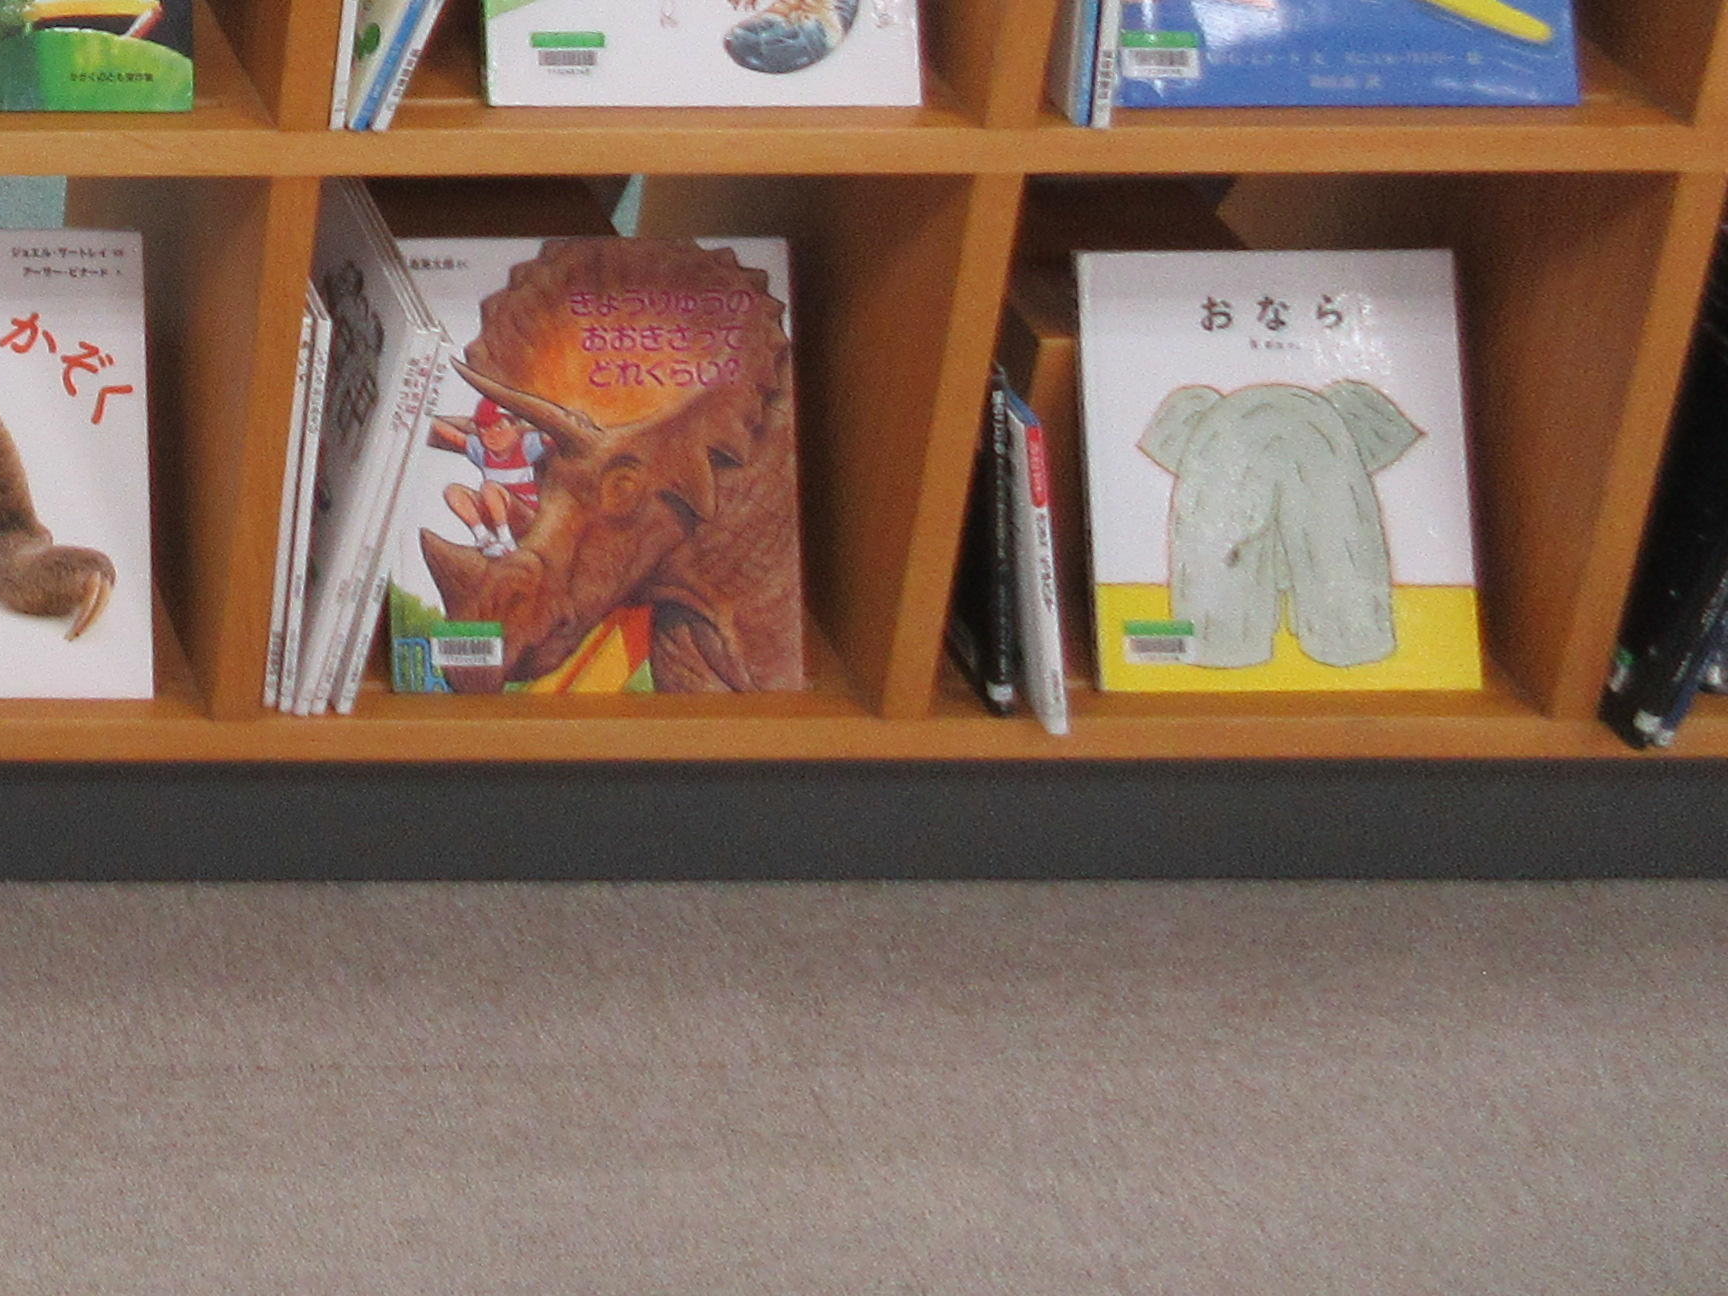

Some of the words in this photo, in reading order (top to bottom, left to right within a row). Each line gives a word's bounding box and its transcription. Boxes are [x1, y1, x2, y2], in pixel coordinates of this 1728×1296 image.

[570, 289, 758, 317] きょうりゅうの
[1199, 293, 1345, 333] おなら
[580, 325, 746, 352] おおきさって
[587, 358, 745, 388] どれくらい?
